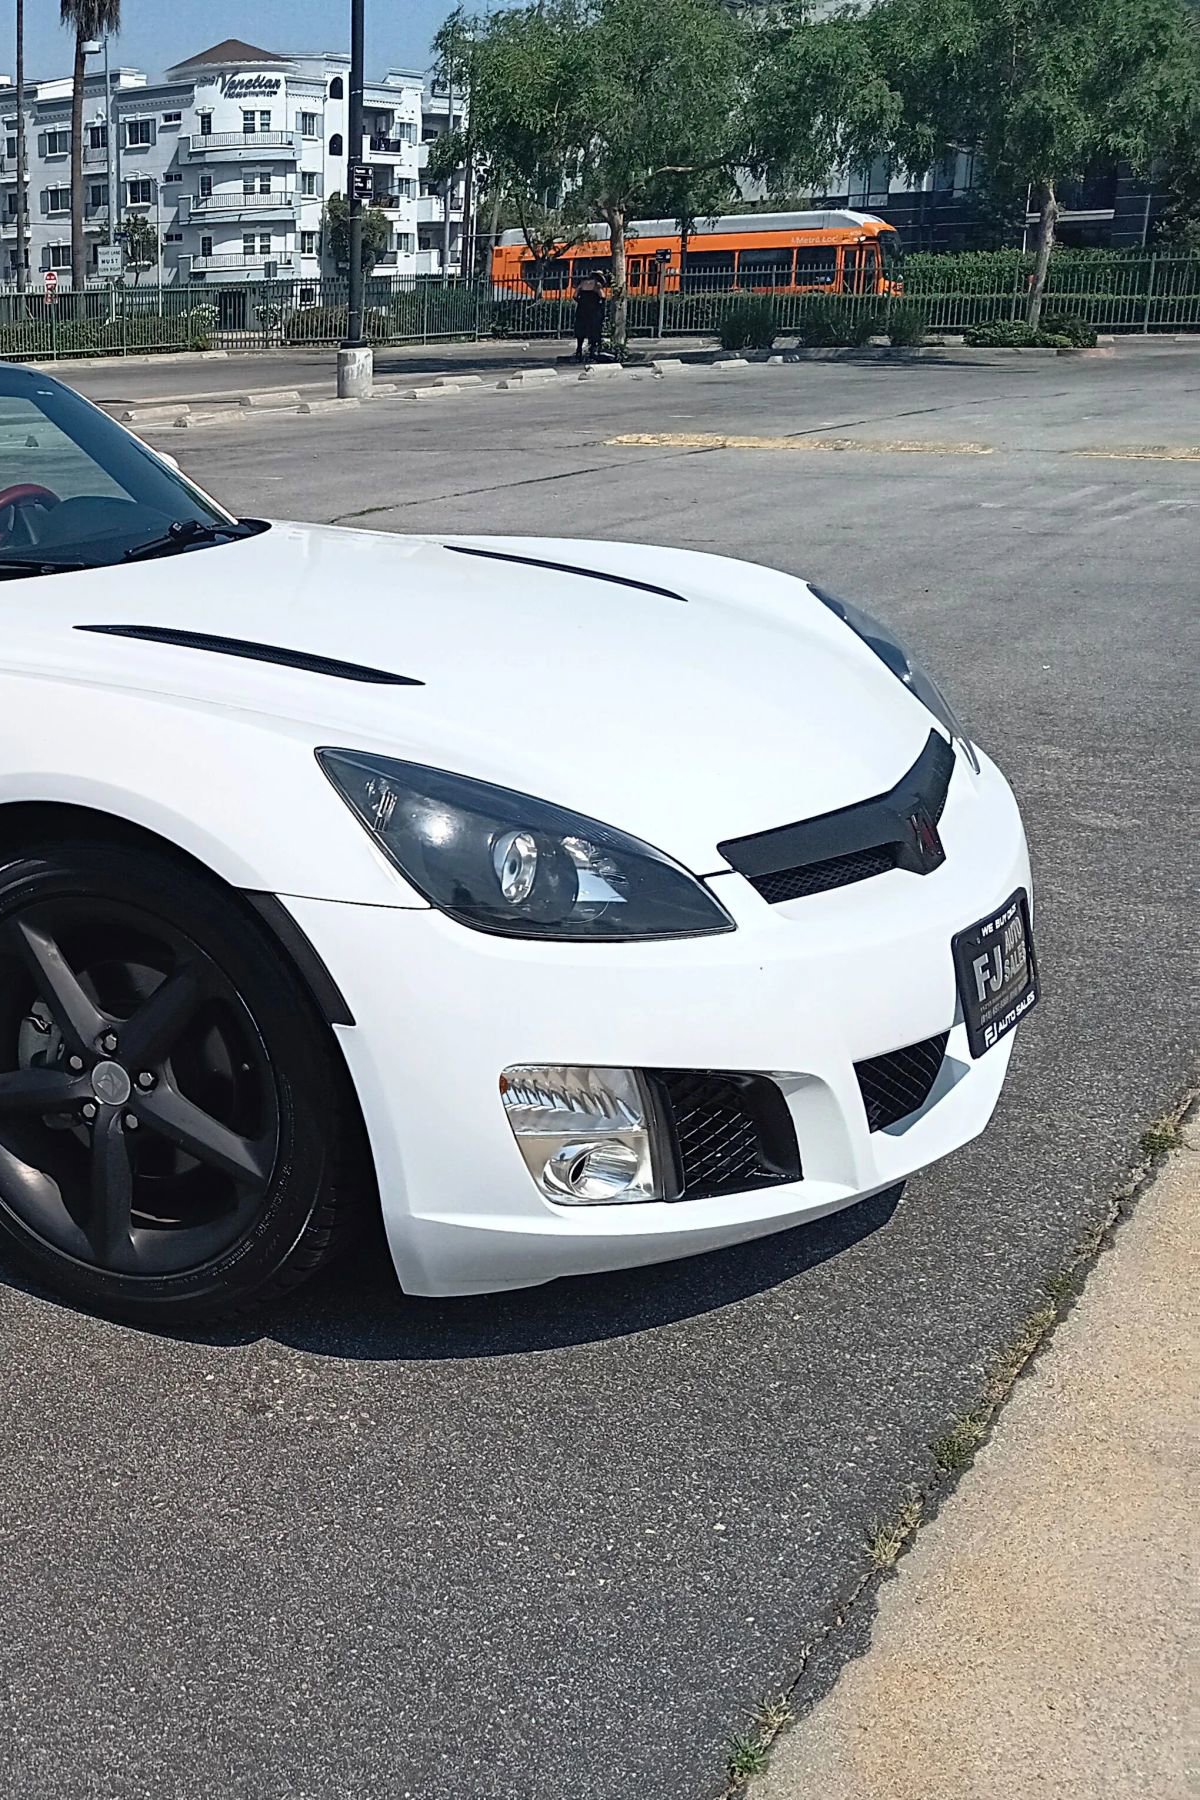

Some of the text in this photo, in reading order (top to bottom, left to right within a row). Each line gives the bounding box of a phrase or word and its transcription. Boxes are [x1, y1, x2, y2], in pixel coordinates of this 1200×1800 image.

[215, 71, 282, 95] Venetian
[981, 922, 994, 937] WE
[1004, 916, 1022, 956] AUTO
[972, 944, 1003, 1002] FJ
[1003, 940, 1027, 983] SALES
[983, 1022, 998, 1048] FJ
[998, 1009, 1015, 1034] AUTO
[1015, 990, 1035, 1016] SALES
